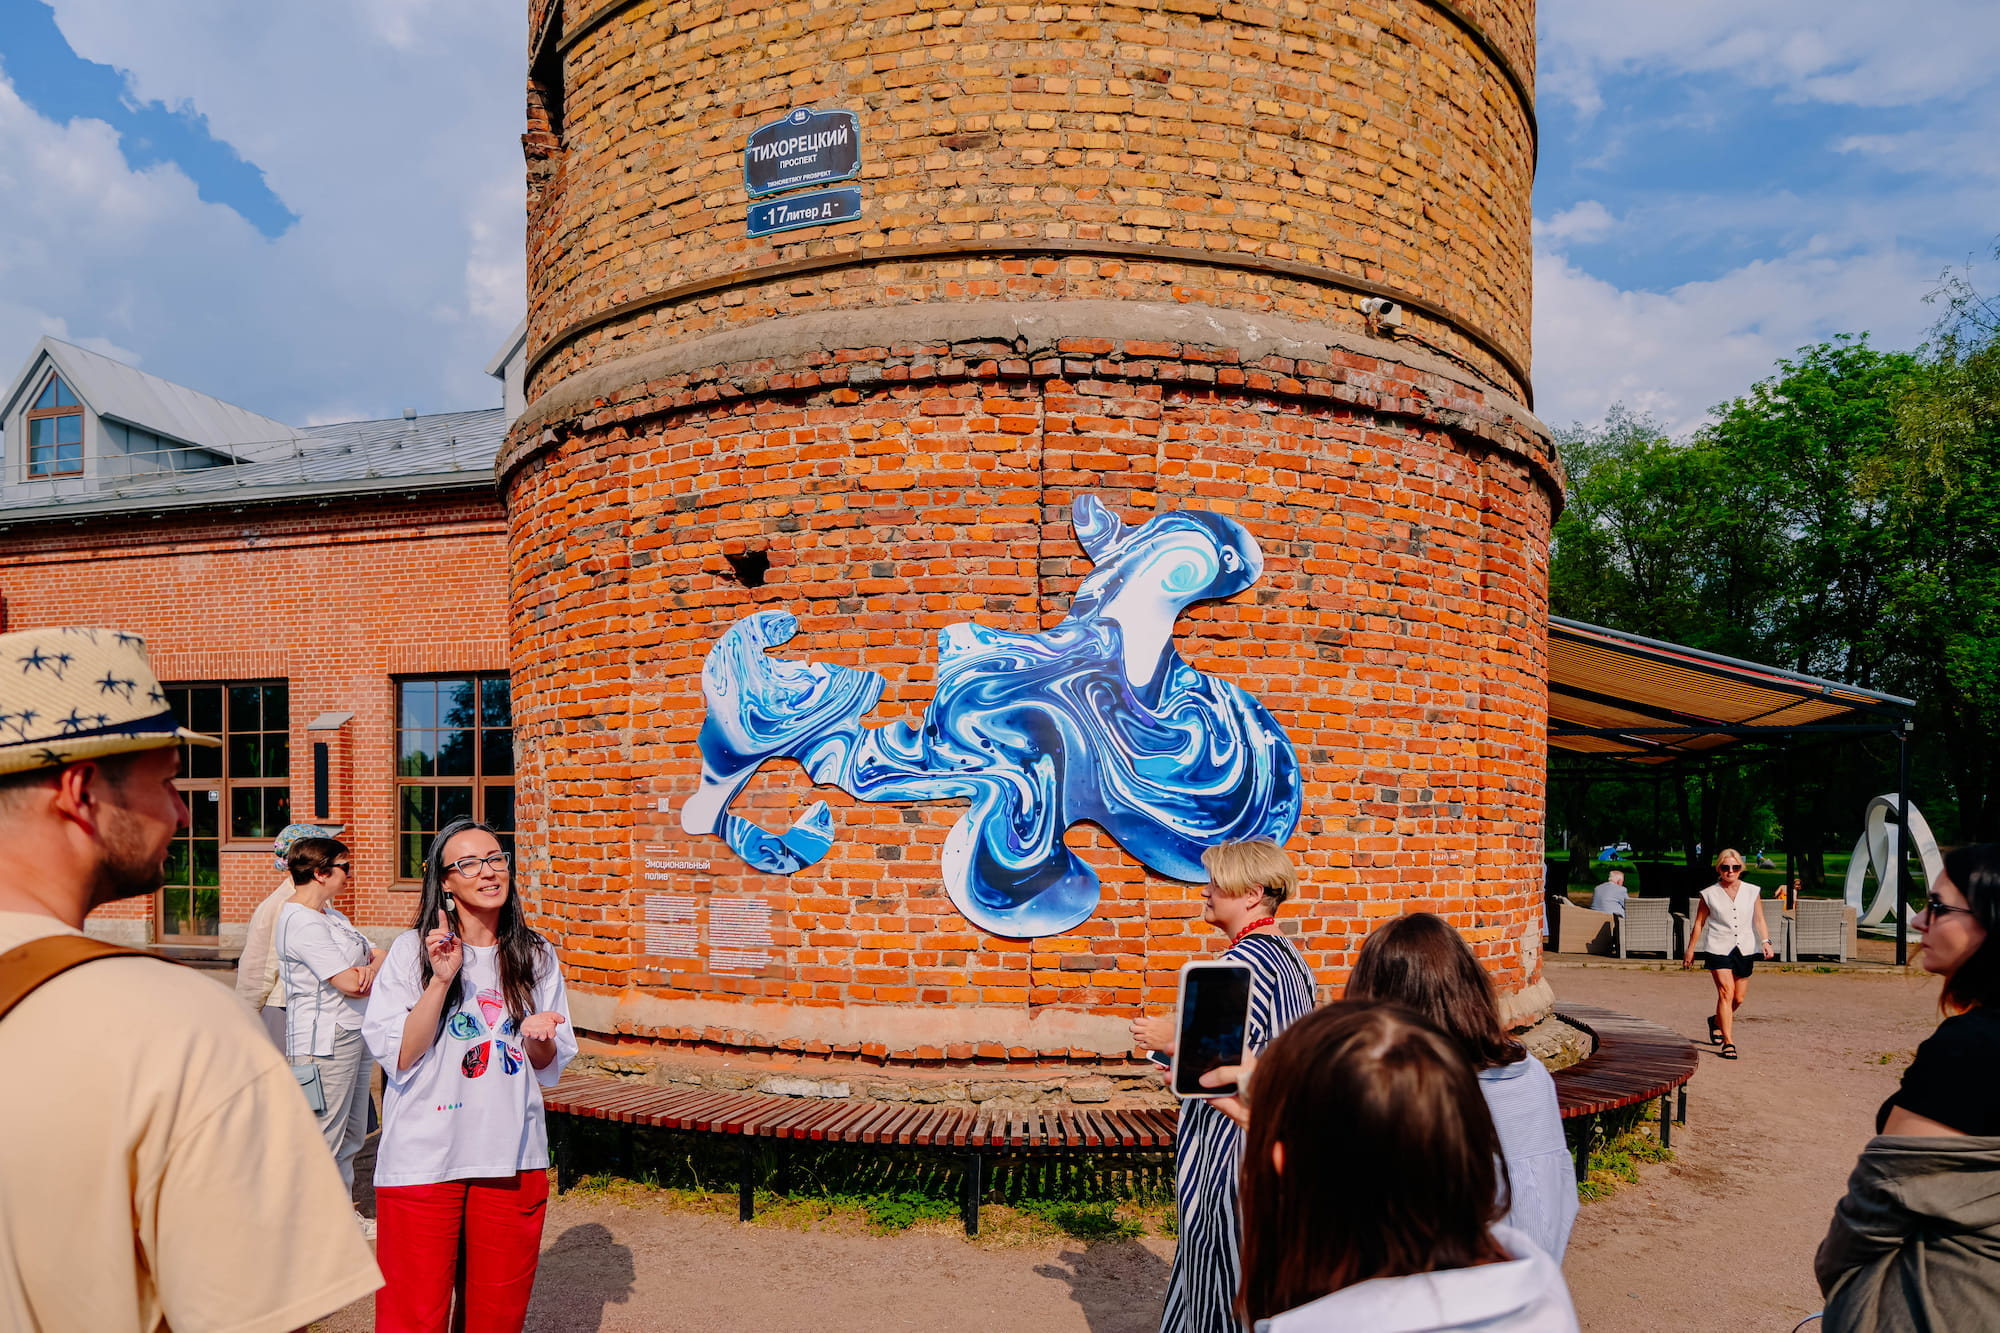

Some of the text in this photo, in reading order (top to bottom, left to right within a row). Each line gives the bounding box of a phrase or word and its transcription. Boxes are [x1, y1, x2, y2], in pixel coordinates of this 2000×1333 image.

[752, 124, 848, 163] ТИХОРЕЦКИЙ
[779, 154, 817, 169] ПРОСПЕКТ
[645, 859, 710, 870] Эмоциональный
[645, 872, 668, 880] полив
